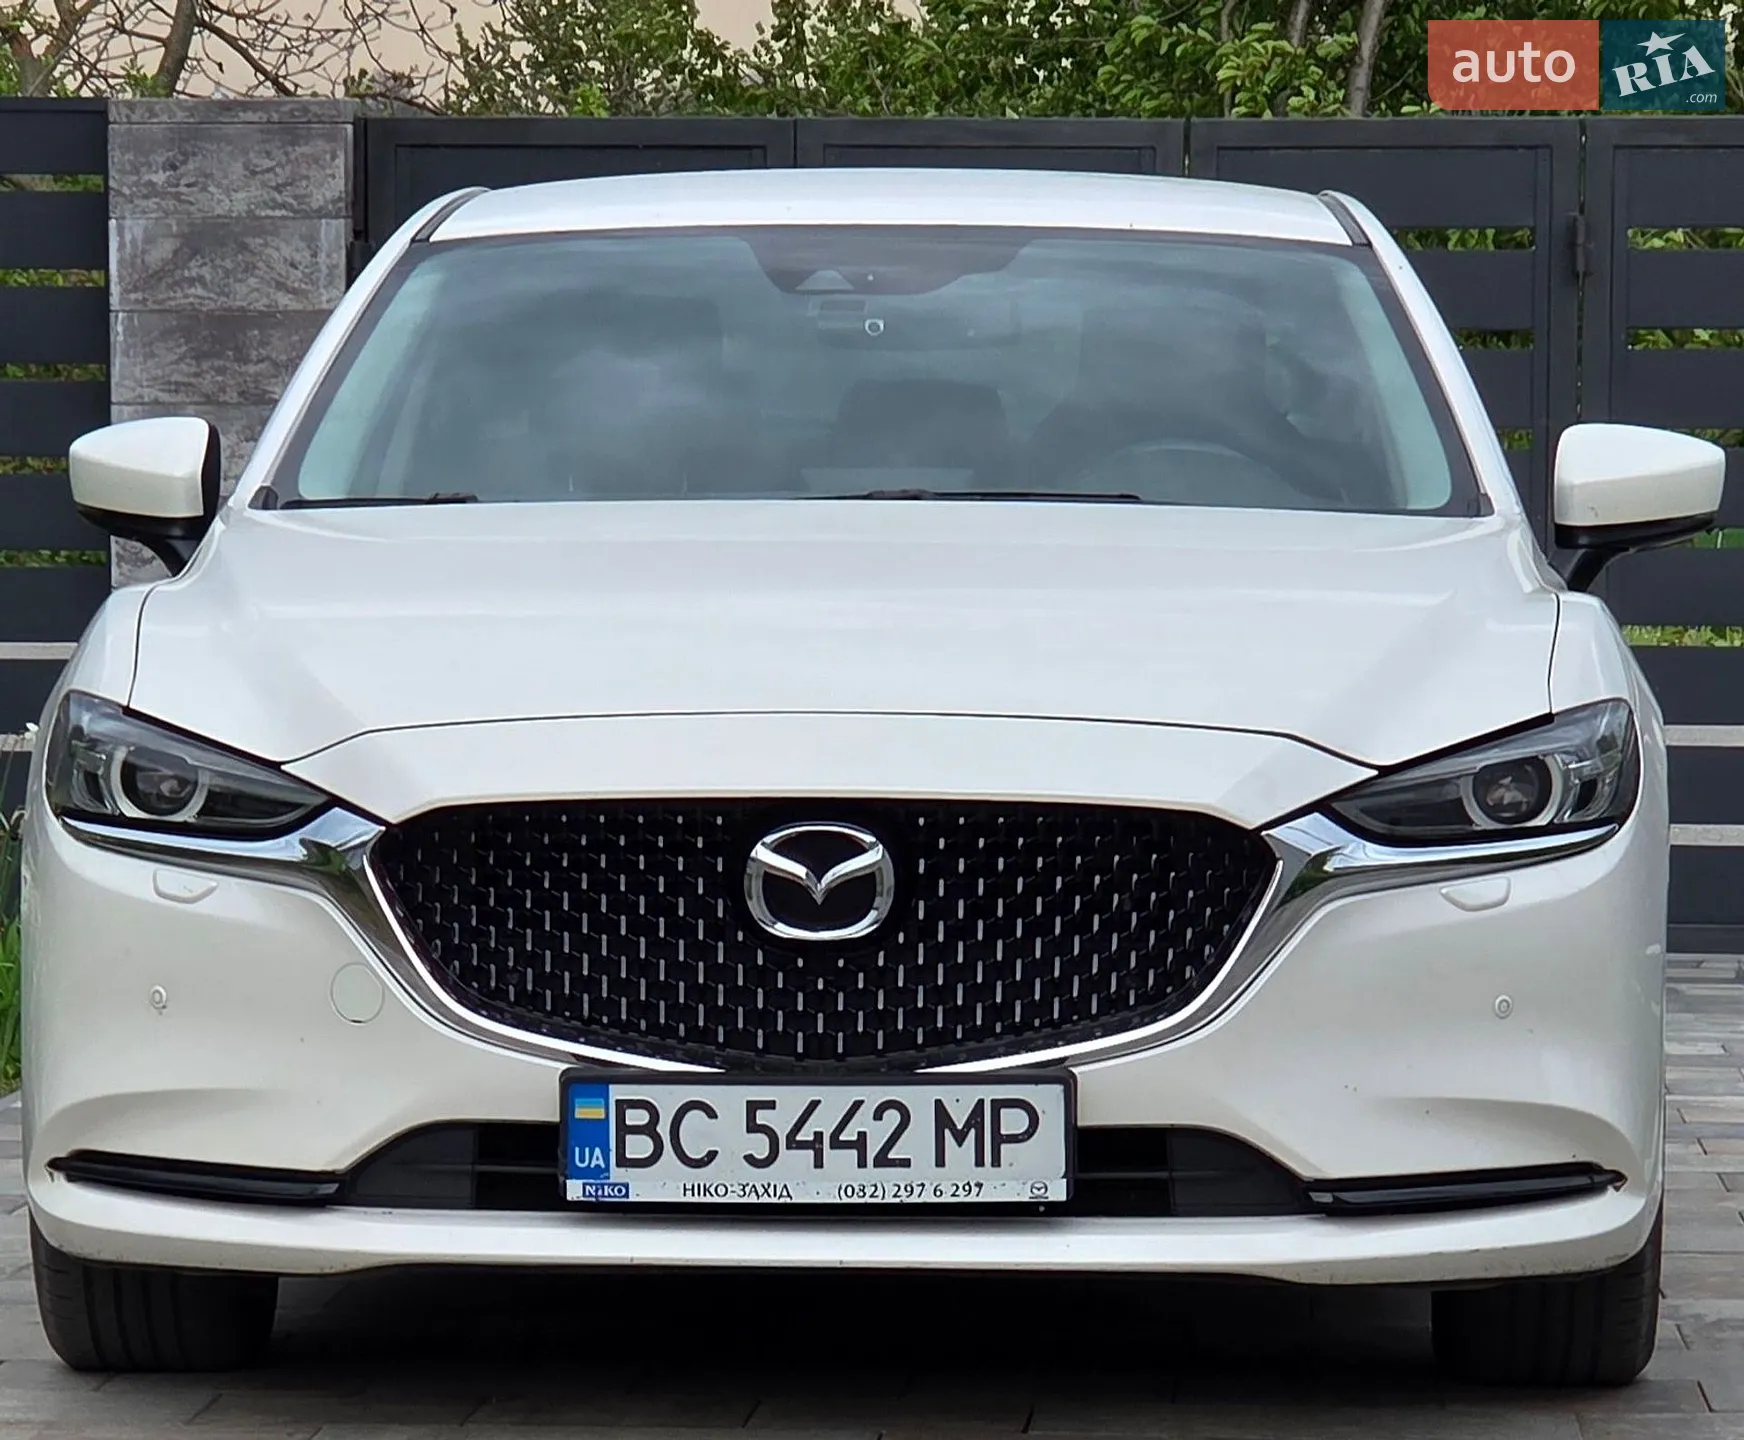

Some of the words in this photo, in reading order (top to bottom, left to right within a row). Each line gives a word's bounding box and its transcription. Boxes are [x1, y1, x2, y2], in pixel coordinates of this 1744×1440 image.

[615, 1099, 719, 1169] BC
[743, 1099, 912, 1169] 5442
[935, 1099, 1040, 1168] MP
[574, 1146, 605, 1169] UA
[837, 1183, 886, 1200] (032)
[892, 1183, 925, 1198] 297
[933, 1184, 943, 1198] 6
[950, 1181, 984, 1197] 297
